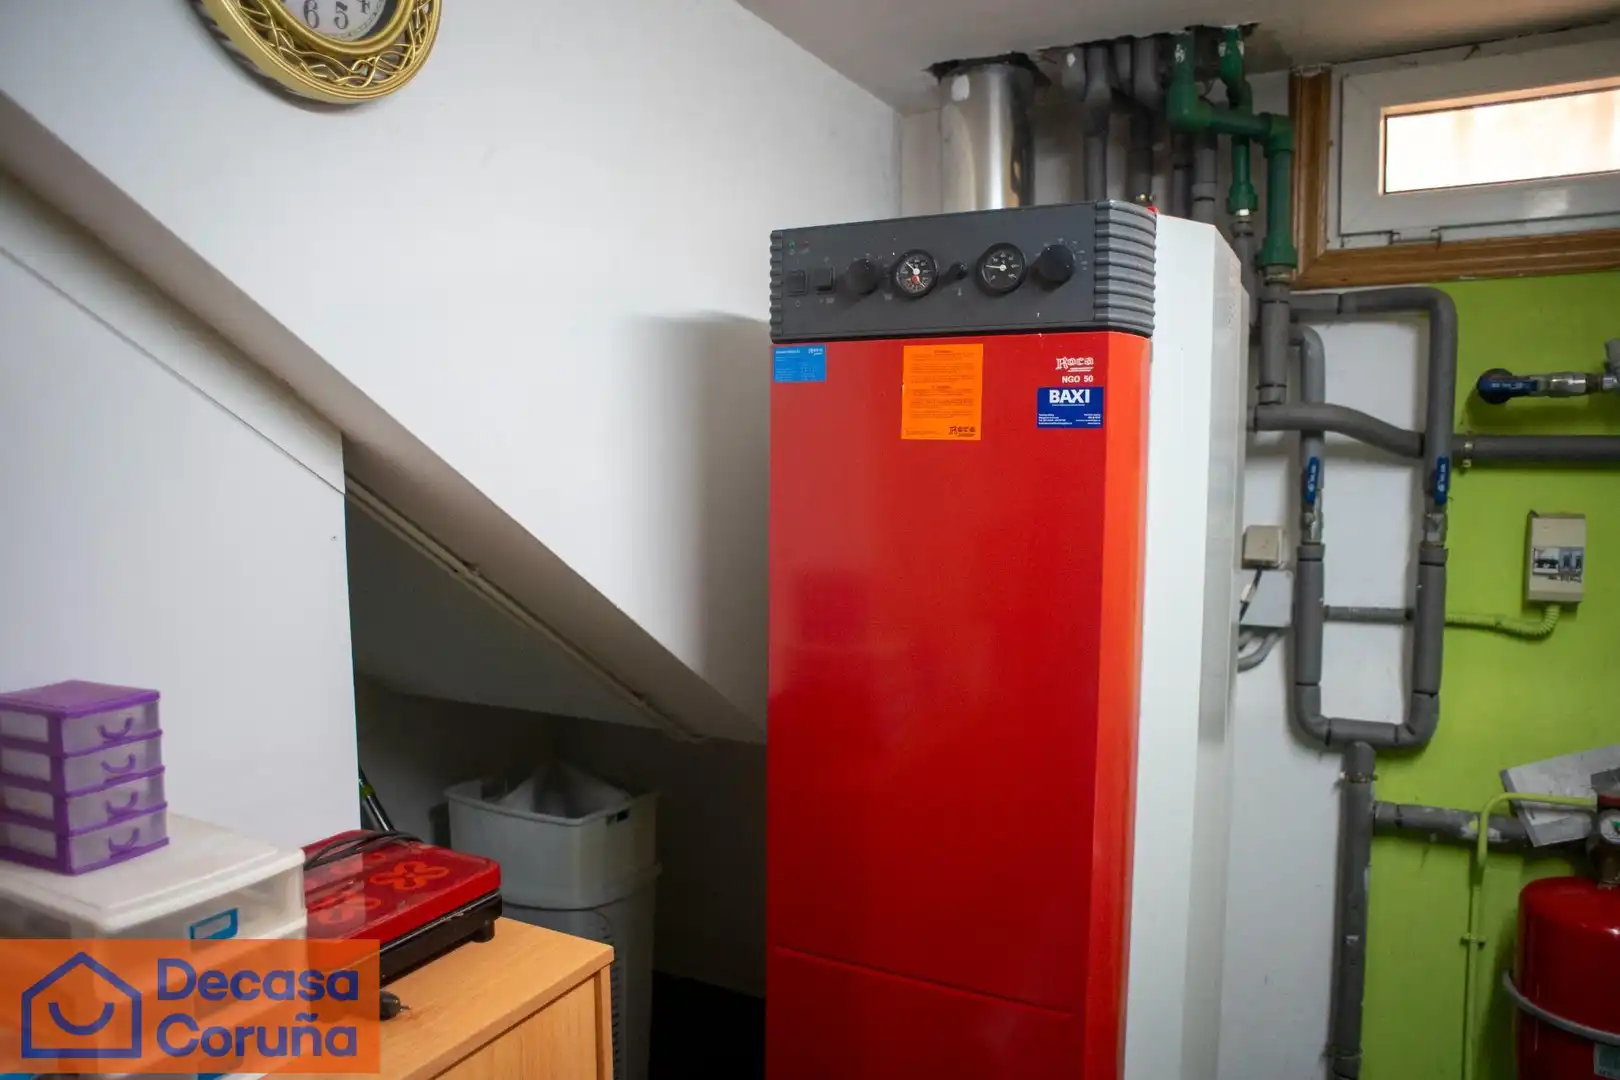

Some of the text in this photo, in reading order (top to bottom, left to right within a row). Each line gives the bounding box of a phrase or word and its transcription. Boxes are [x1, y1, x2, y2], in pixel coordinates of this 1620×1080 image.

[303, 0, 320, 29] 6
[334, 1, 349, 30] 5
[1055, 357, 1094, 370] Roca
[1062, 375, 1094, 383] NGO 50
[1049, 389, 1090, 403] BAXI
